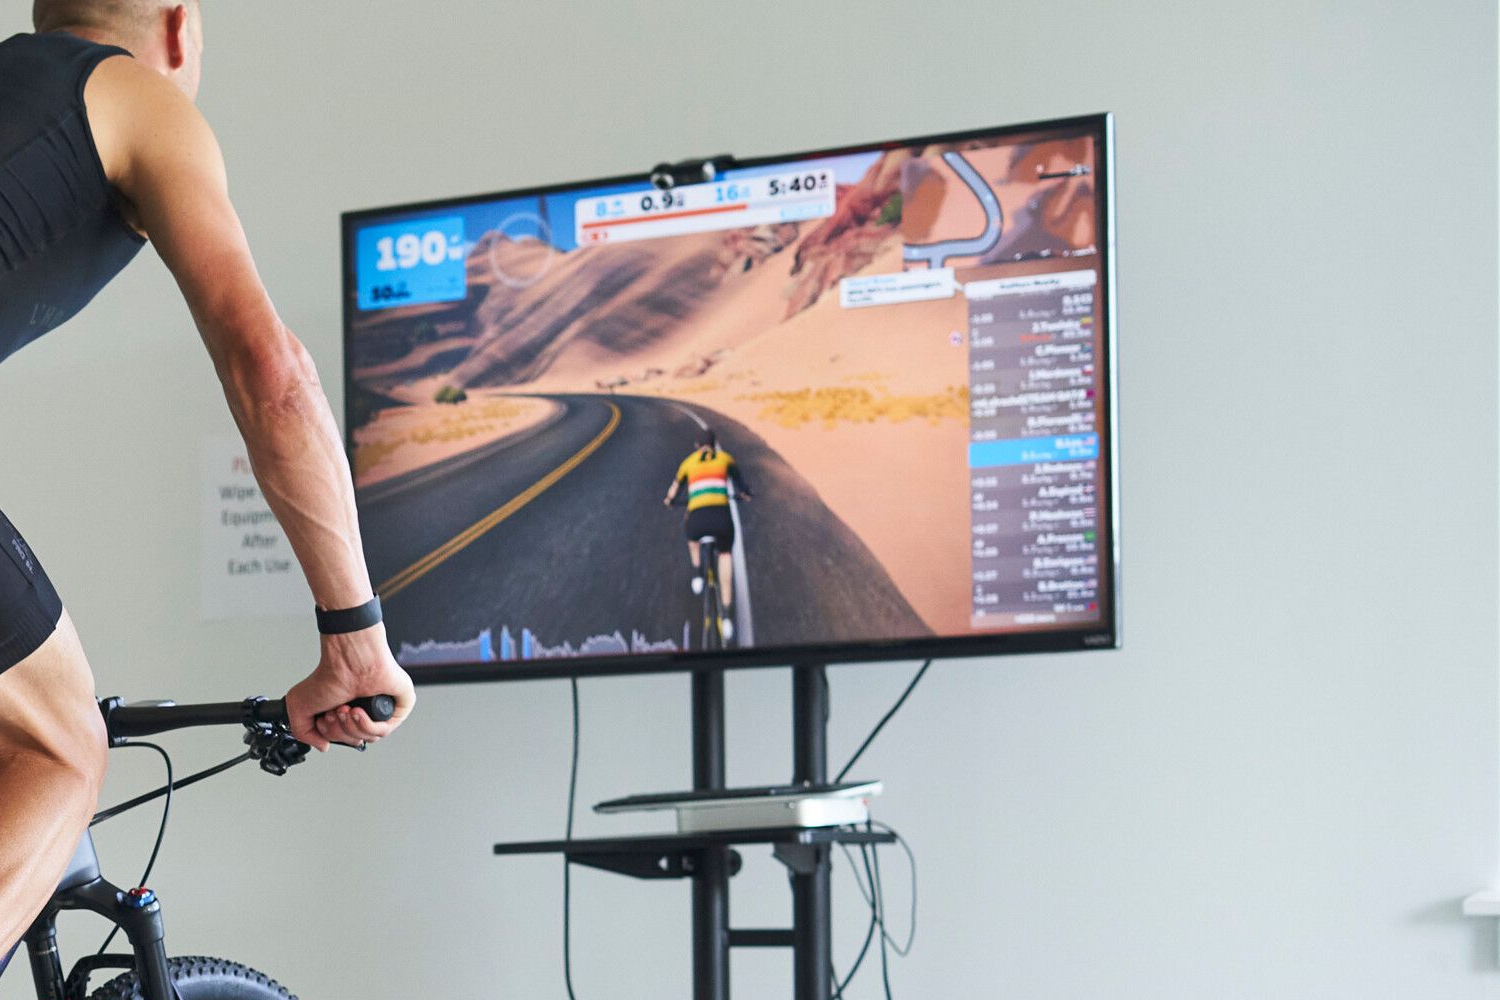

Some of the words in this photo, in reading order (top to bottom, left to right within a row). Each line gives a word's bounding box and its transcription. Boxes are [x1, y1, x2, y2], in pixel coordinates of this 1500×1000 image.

[376, 230, 447, 271] 190
[219, 485, 256, 500] Wipe
[242, 534, 277, 548] After
[228, 558, 262, 575] Each
